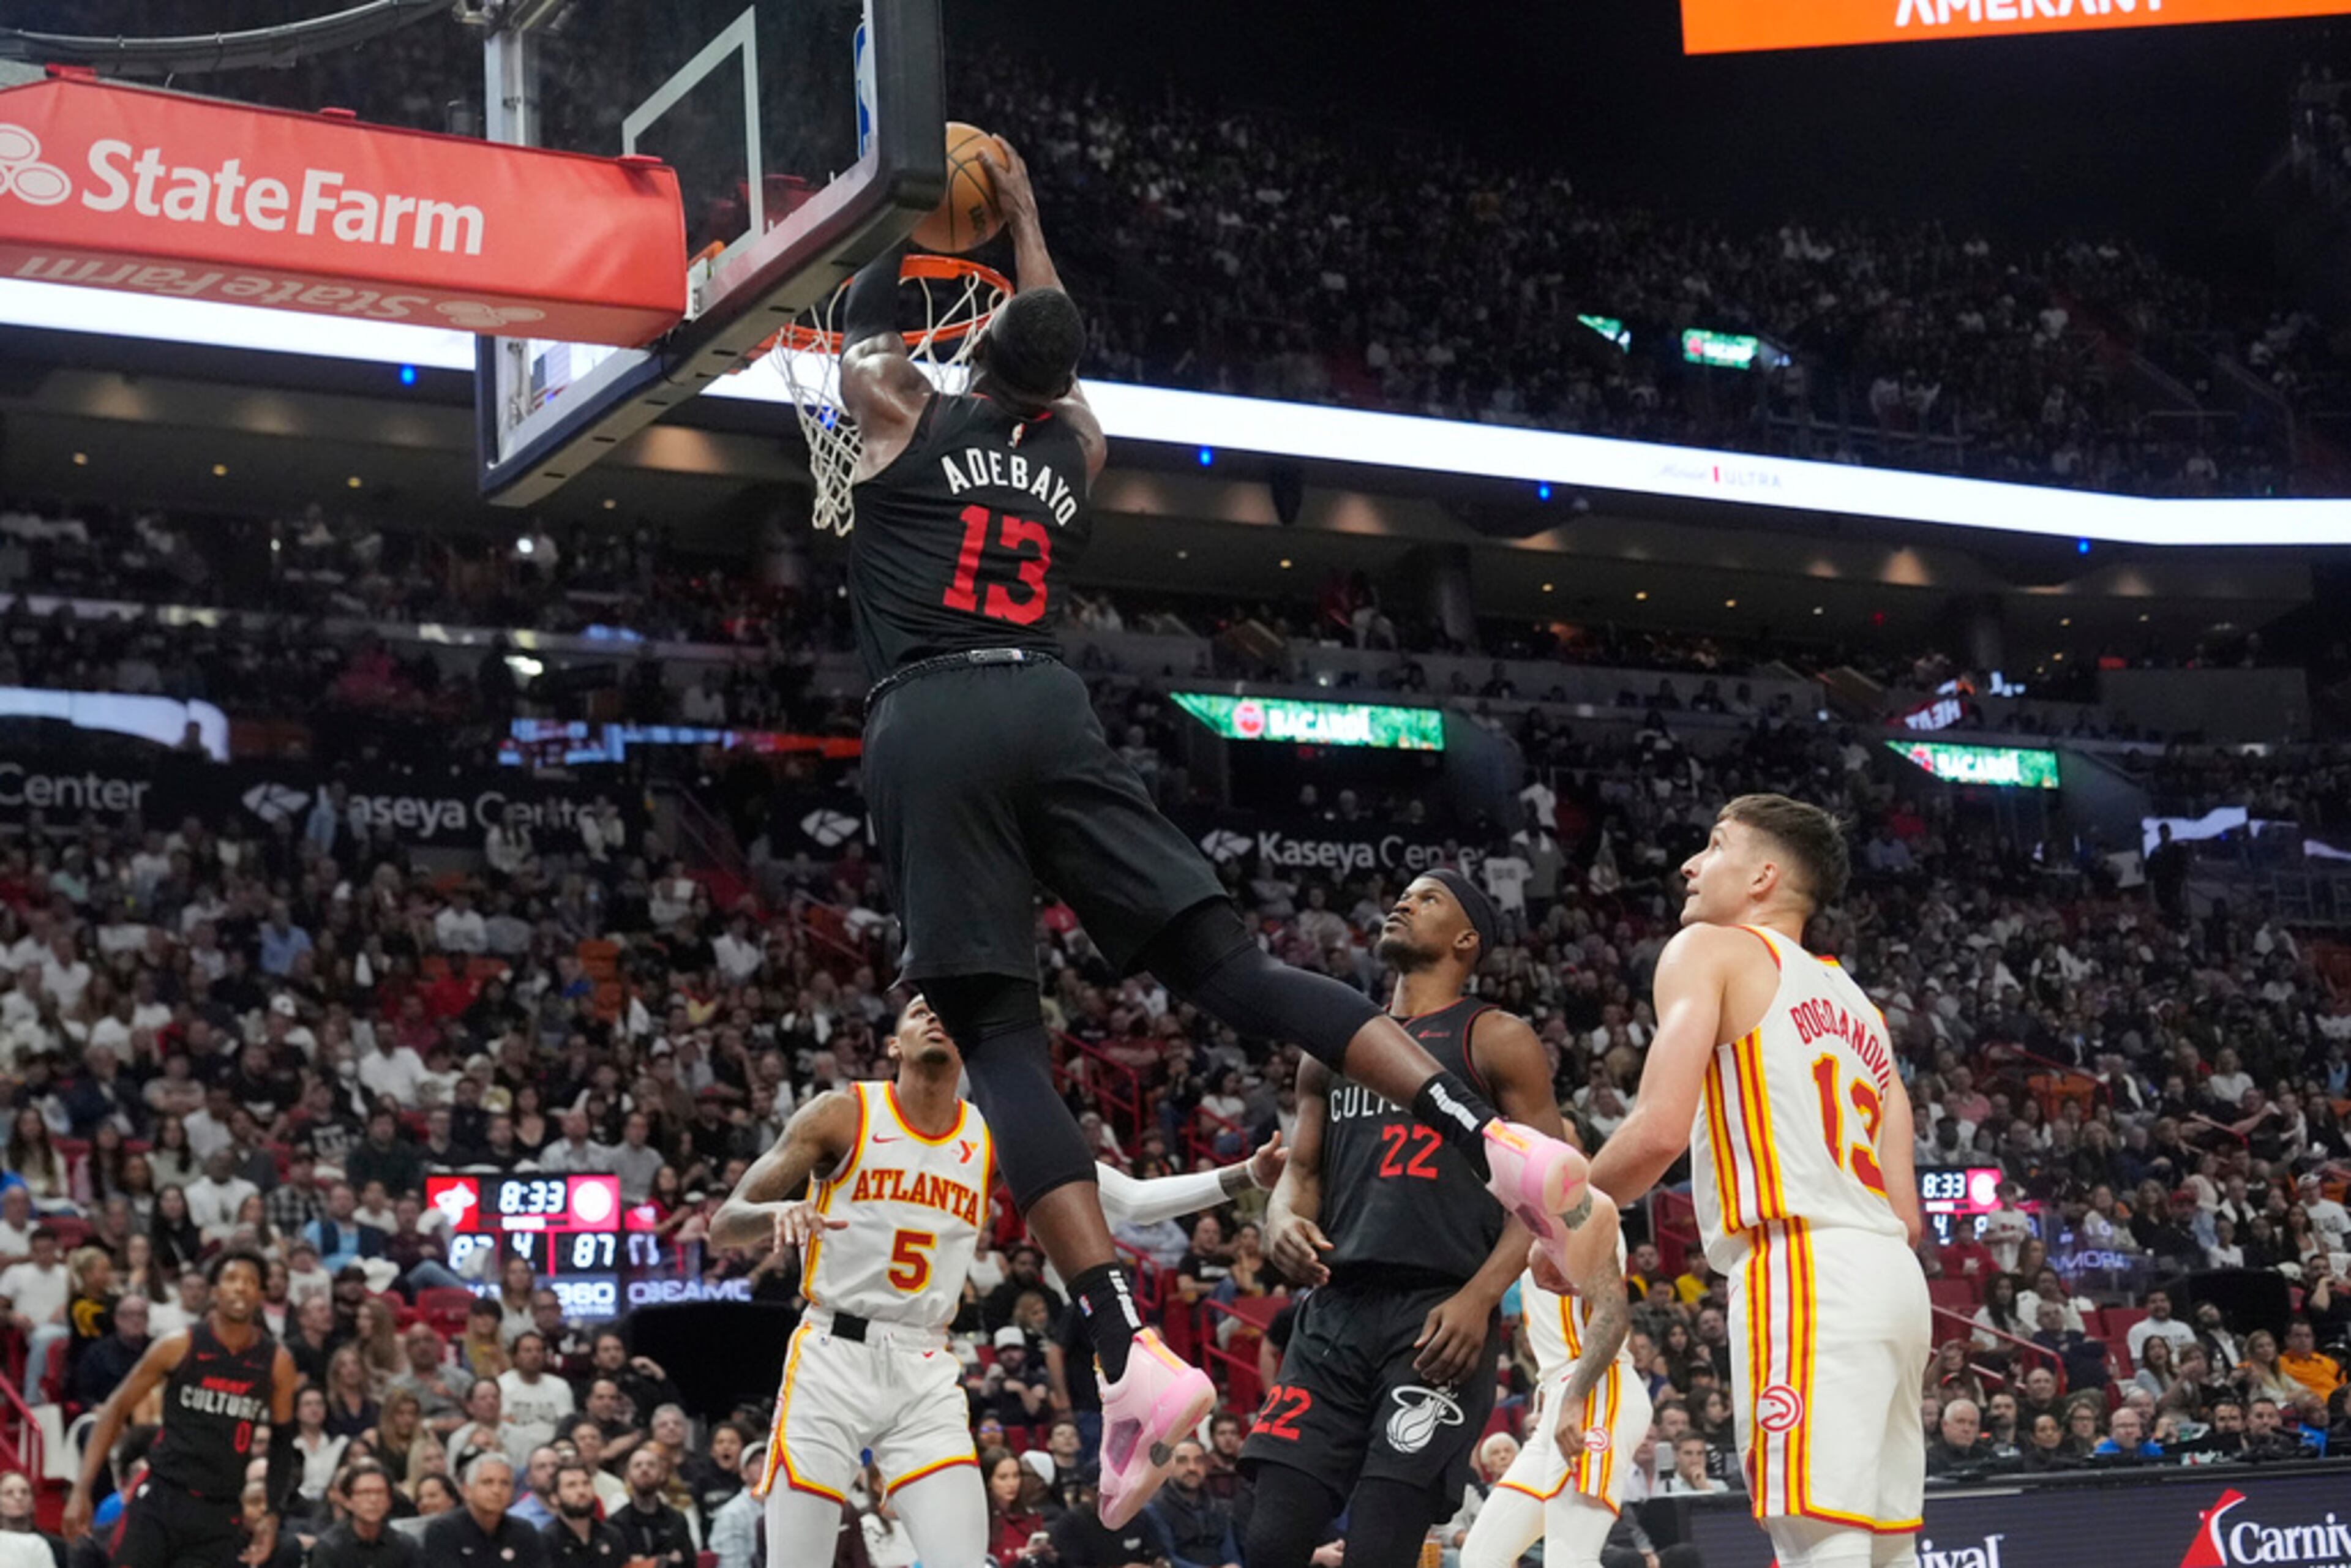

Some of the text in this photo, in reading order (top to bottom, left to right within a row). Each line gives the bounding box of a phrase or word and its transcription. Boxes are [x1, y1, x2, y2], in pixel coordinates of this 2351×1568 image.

[1894, 0, 2161, 26] AMER
[940, 448, 1078, 527] ADEBAYO
[942, 504, 1052, 626] 13
[0, 762, 151, 811] Center
[349, 794, 467, 839] aseya
[1258, 831, 1485, 875] Kaseya Cene
[1811, 1051, 1889, 1199] 13
[1379, 1123, 1443, 1180] 22
[499, 1180, 566, 1214] 8:33
[850, 1168, 980, 1228] ATLANTA
[1923, 1172, 1967, 1199] 8:33
[573, 1233, 616, 1268] 87
[887, 1228, 937, 1294] 5
[234, 1419, 252, 1454] 0
[1250, 1384, 1312, 1441] 22
